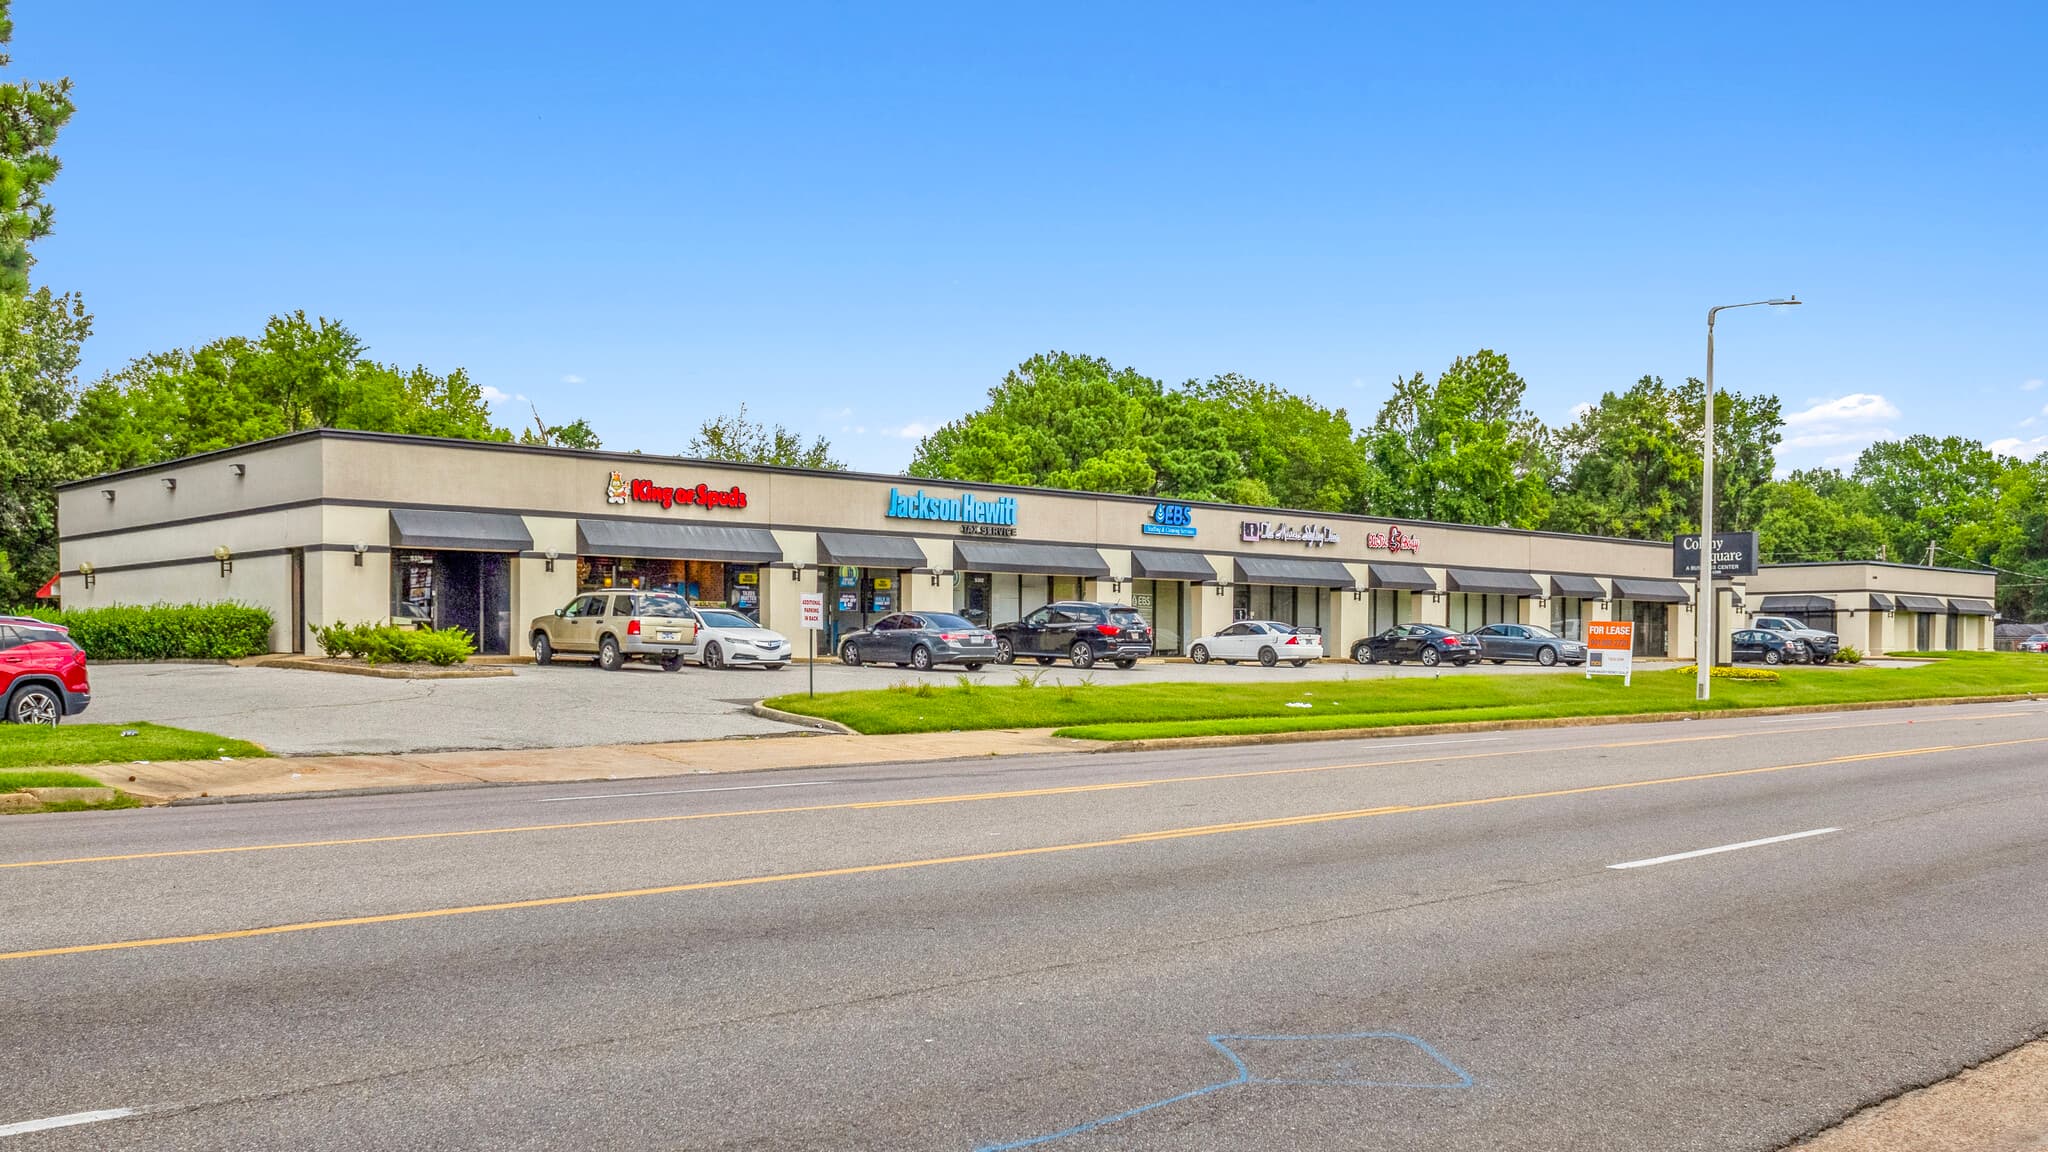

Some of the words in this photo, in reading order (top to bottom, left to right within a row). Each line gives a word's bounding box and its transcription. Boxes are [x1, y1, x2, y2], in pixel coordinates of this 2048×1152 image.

[631, 479, 673, 509] King
[695, 483, 747, 510] Spuds
[886, 487, 961, 521] Jackson
[962, 493, 1017, 525] Hewitt
[1165, 505, 1192, 526] EBS
[961, 524, 979, 534] TAX
[980, 525, 1017, 536] SERVICE
[1683, 536, 1723, 551] Colny
[1711, 551, 1743, 564] quare
[1138, 595, 1150, 606] EBS
[1590, 626, 1604, 635] FOR
[1606, 626, 1631, 636] LEASE
